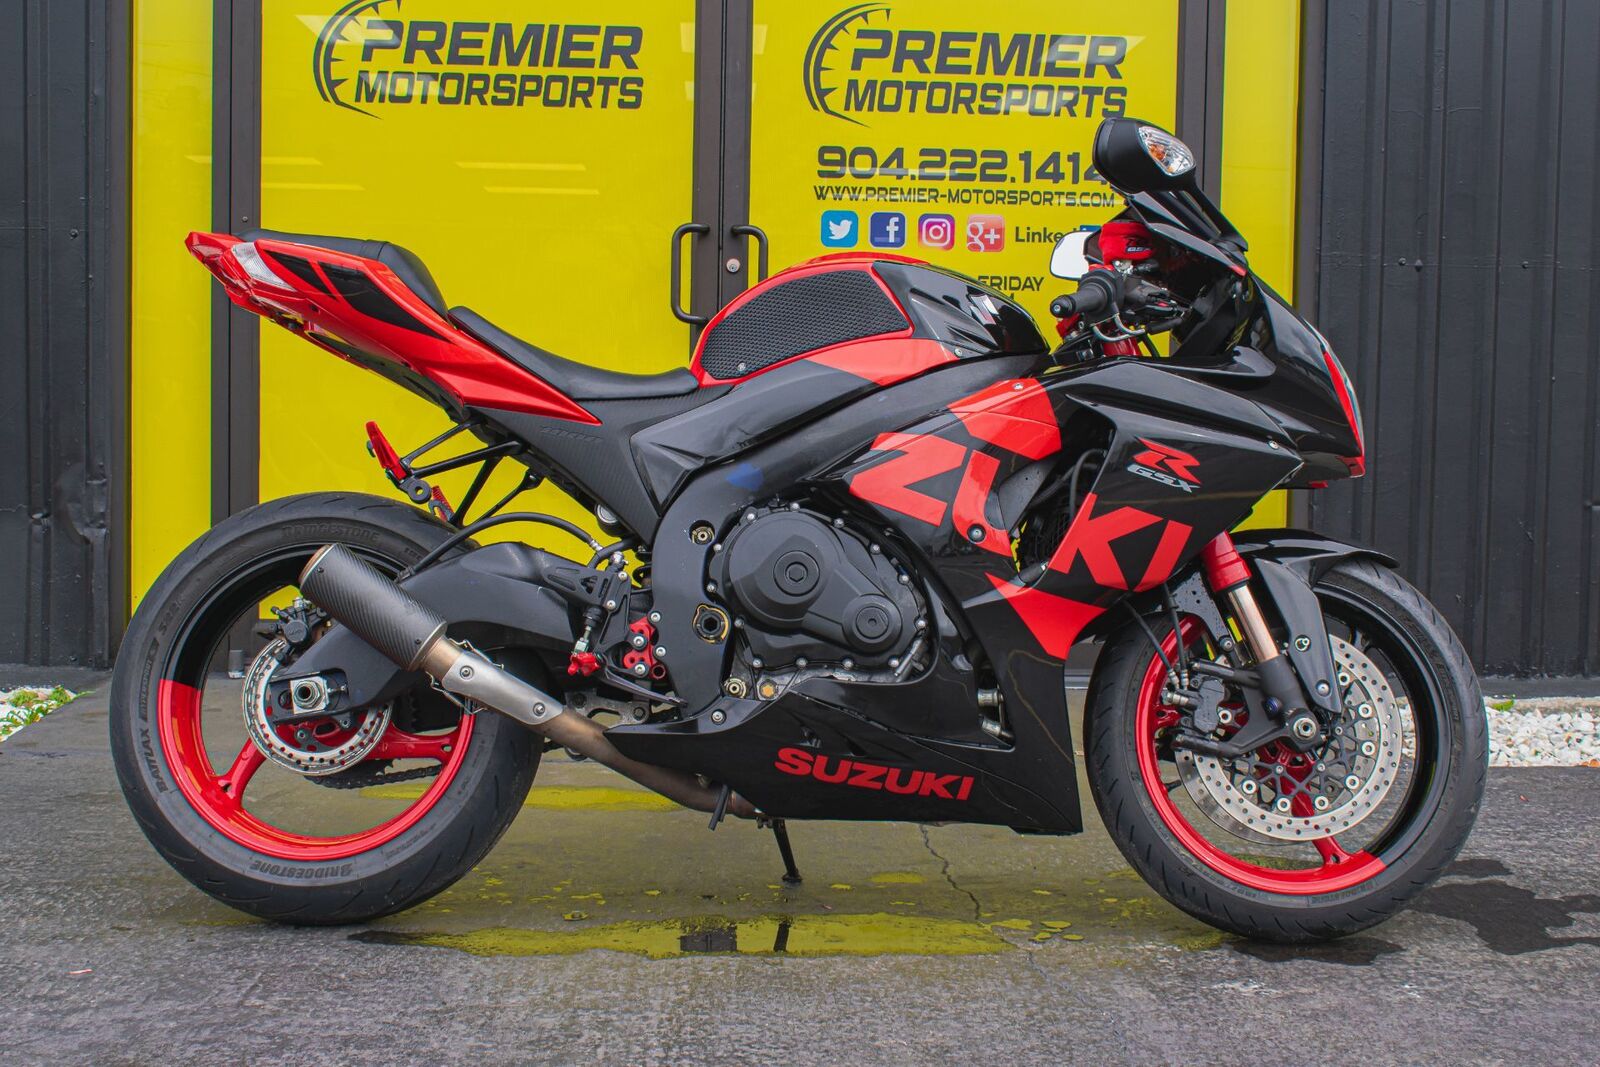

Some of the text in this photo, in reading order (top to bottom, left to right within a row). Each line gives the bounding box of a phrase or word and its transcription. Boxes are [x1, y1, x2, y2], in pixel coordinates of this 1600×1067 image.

[361, 19, 644, 69] PREMIER
[850, 29, 1128, 79] PREMIER
[354, 70, 644, 109] MOTORSPORTS
[843, 79, 1128, 118] MOTORSPORTS
[813, 185, 1115, 208] WWW.PREMIER-MOTORSPORTS.COM
[1015, 226, 1077, 243] Linke
[774, 747, 974, 801] SUZUKI
[249, 860, 353, 879] BRIDGESTONE
